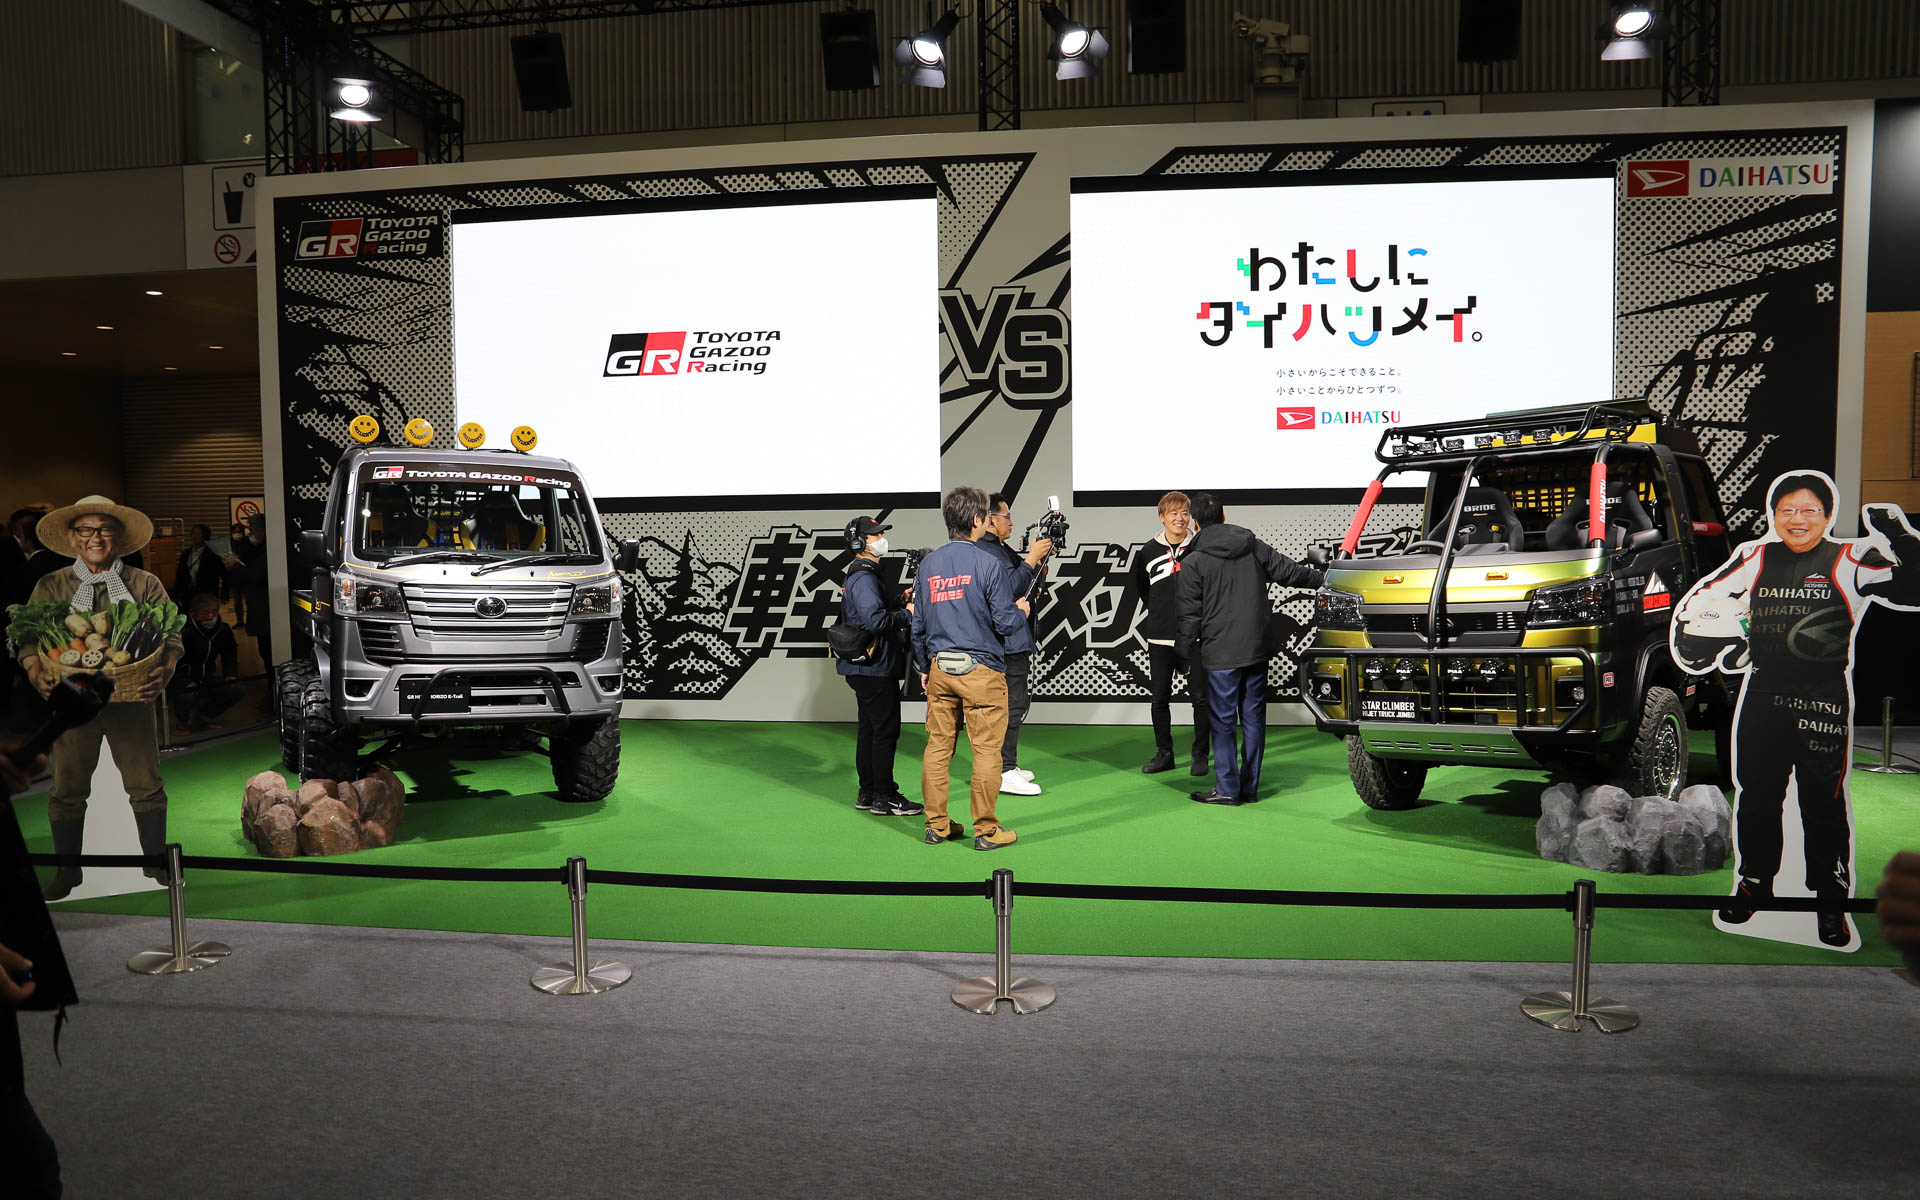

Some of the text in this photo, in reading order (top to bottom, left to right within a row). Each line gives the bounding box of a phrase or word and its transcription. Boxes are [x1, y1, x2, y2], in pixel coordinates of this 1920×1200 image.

[1699, 164, 1829, 188] DAIHATSU
[367, 215, 439, 230] TOYOTA
[365, 229, 431, 242] GAZOO
[298, 234, 358, 257] GR
[361, 241, 428, 255] Racing
[1236, 241, 1428, 293] わたしに
[693, 330, 781, 344] TOYOTA
[939, 286, 1070, 401] VS
[689, 346, 771, 358] GAZOO
[606, 348, 680, 375] GR
[686, 360, 767, 376] Racing
[1276, 367, 1402, 378] 小さいからこそできること。
[1276, 385, 1402, 396] 小さいことからひとつずつ。
[1321, 410, 1401, 424] DAIHATSU
[406, 469, 467, 478] TOYOTA
[469, 471, 522, 482] GAZOO
[522, 475, 572, 489] Racing
[1463, 503, 1496, 512] BRIDE
[927, 574, 973, 590] Toyota
[930, 589, 964, 604] Times
[1758, 587, 1832, 600] DAIHATSU
[1361, 700, 1415, 711] STAR CLIMBER
[1361, 710, 1416, 719] HIJET TRUCK JUMBO
